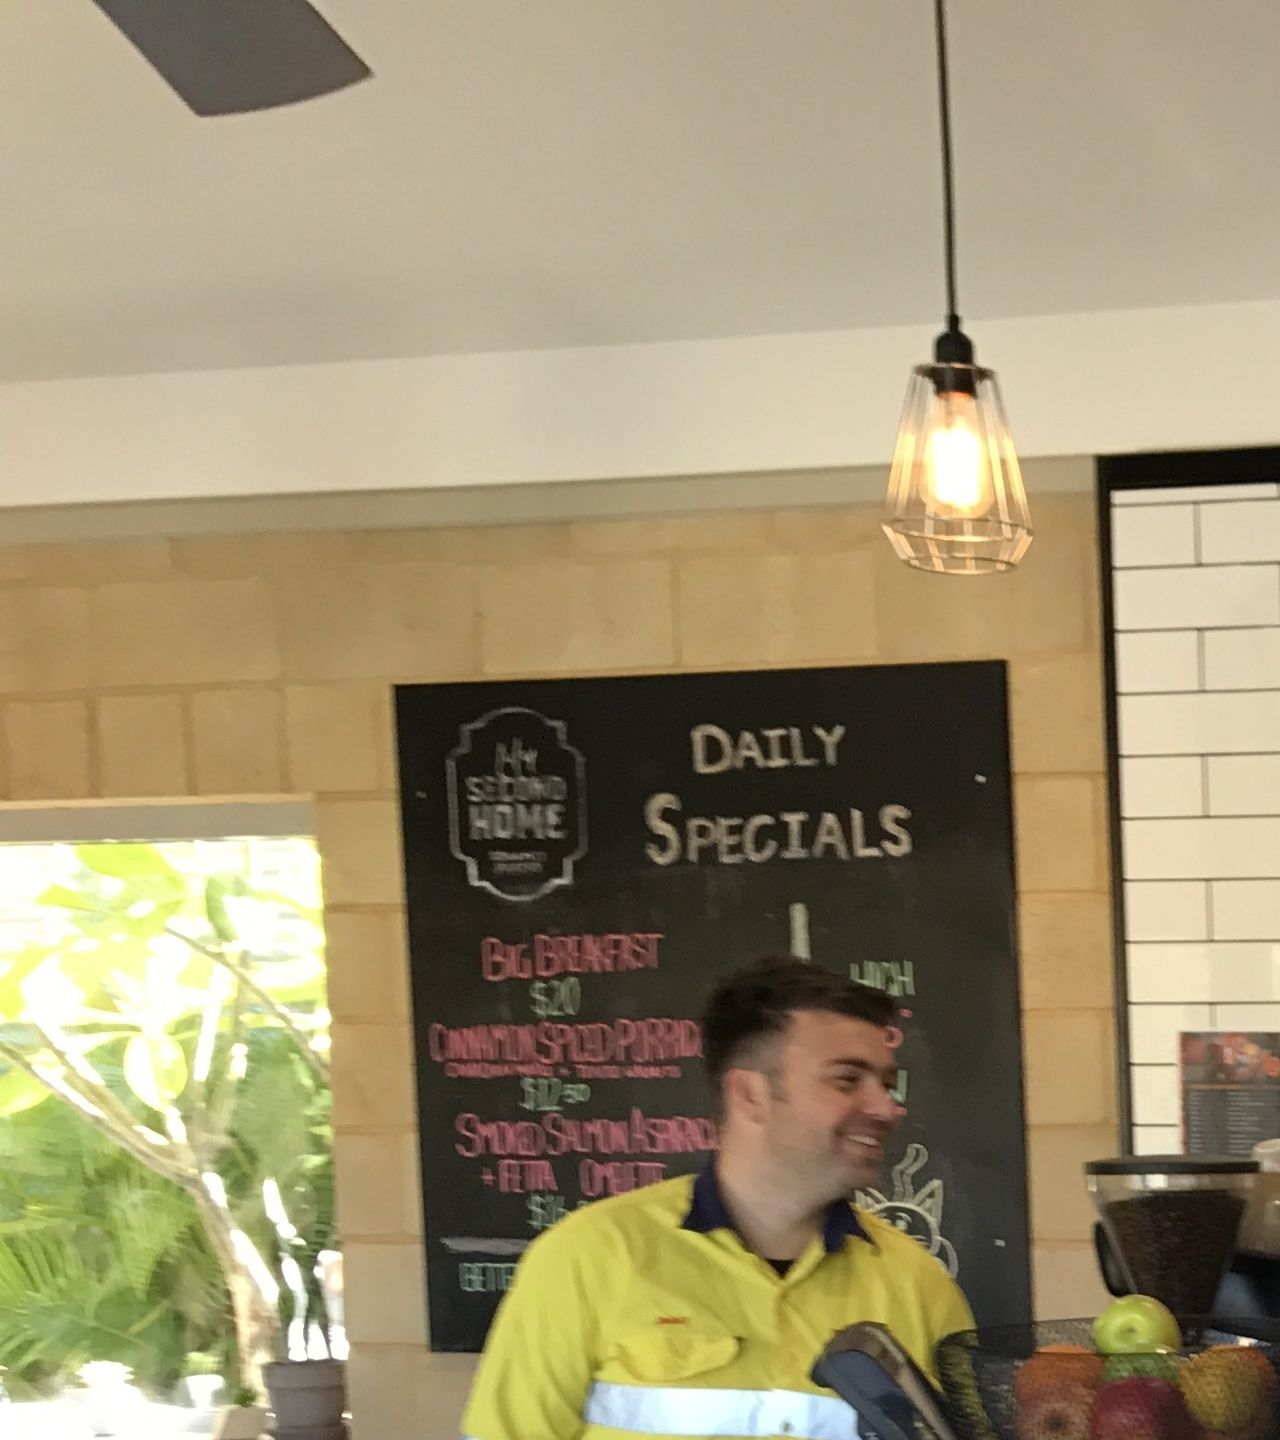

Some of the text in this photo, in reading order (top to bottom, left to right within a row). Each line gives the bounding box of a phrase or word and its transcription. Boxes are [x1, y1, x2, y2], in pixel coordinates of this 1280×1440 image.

[690, 723, 846, 774] DAILY
[468, 803, 569, 840] HOME
[643, 792, 914, 866] SPECIALS
[534, 932, 665, 977] BREAKFAST
